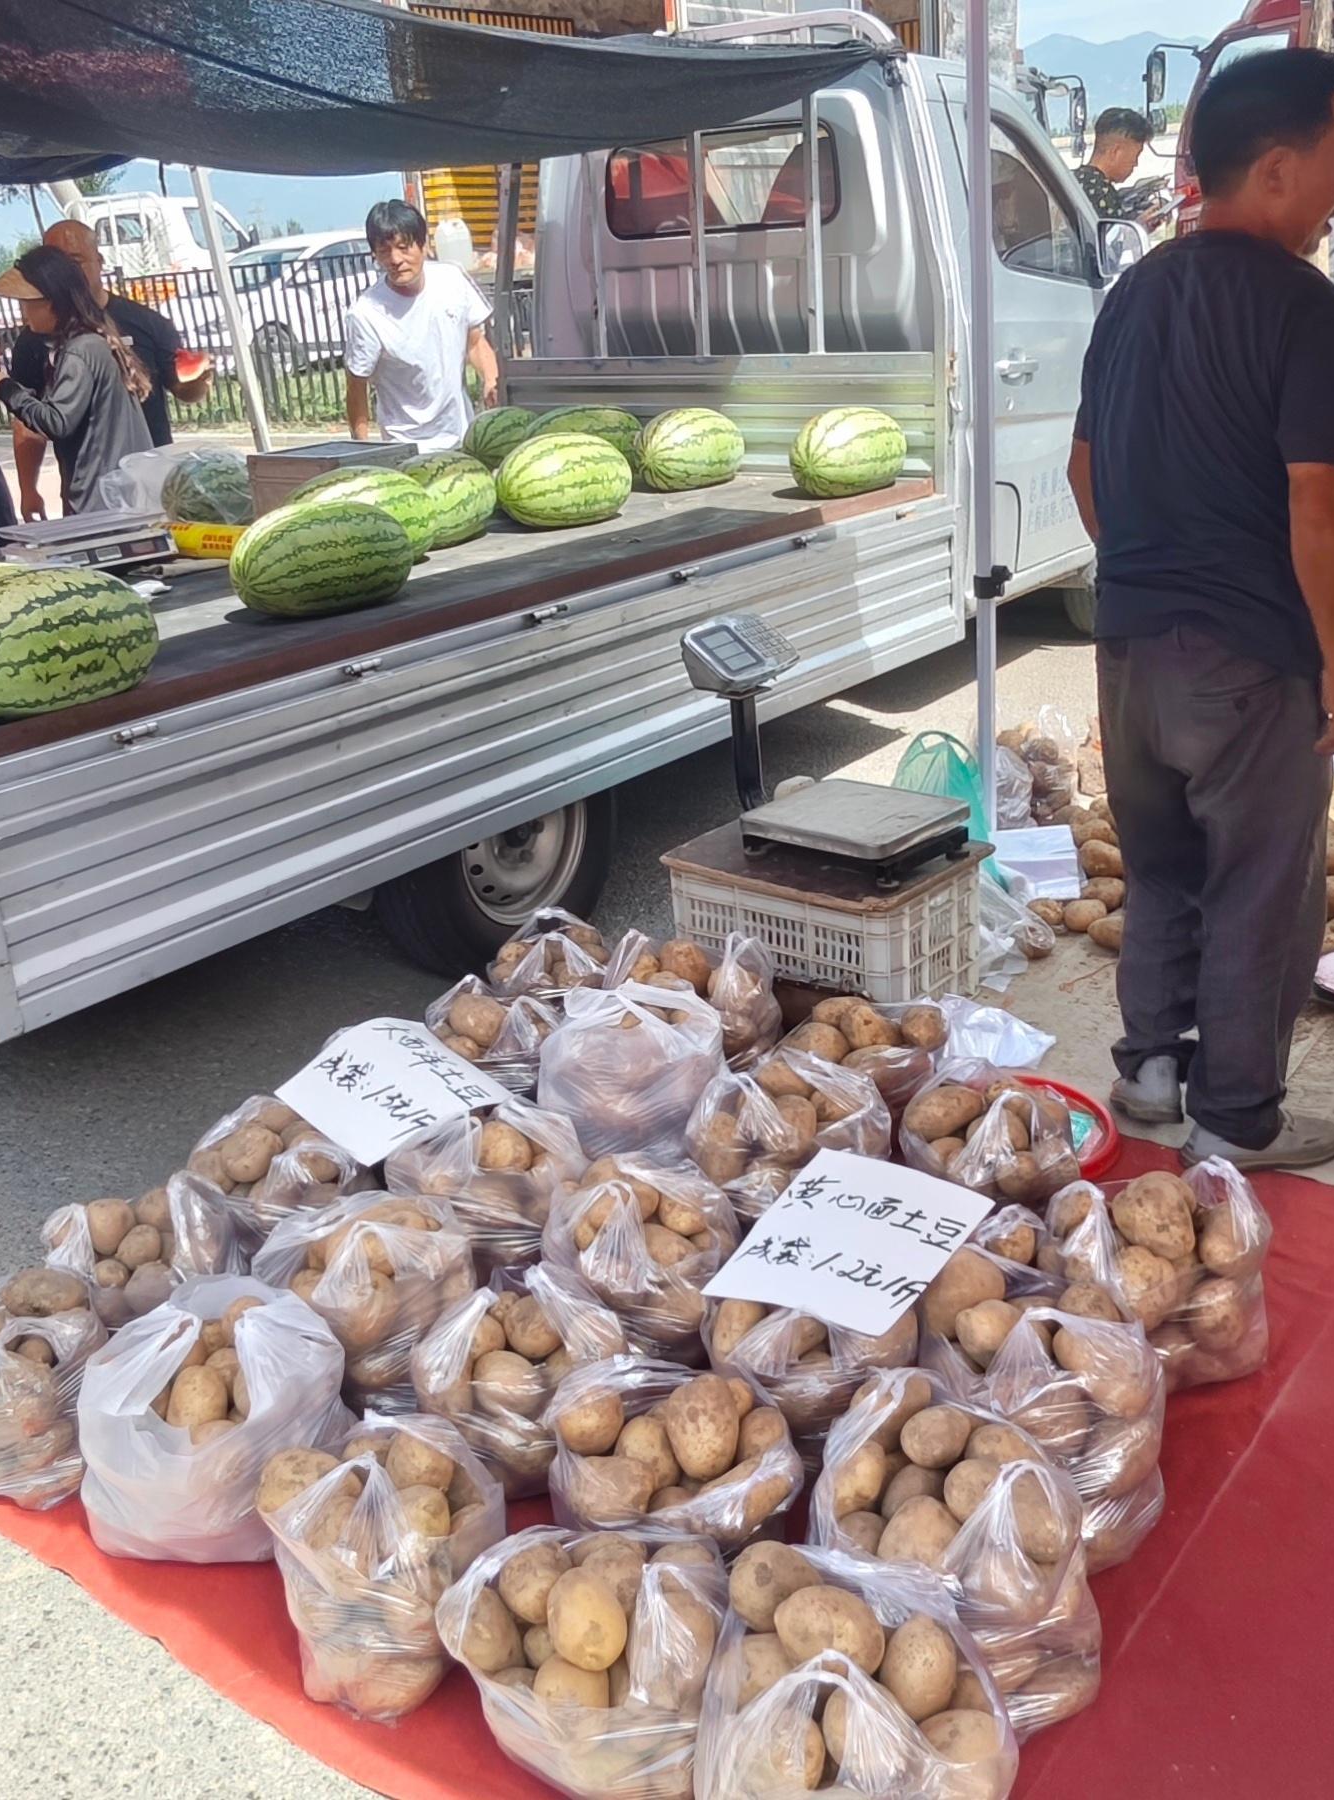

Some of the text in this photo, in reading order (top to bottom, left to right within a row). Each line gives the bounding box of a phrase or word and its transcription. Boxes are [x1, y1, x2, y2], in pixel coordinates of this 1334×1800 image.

[371, 1023, 492, 1108] 大西洋土豆
[782, 1175, 967, 1252] 黄心面土豆
